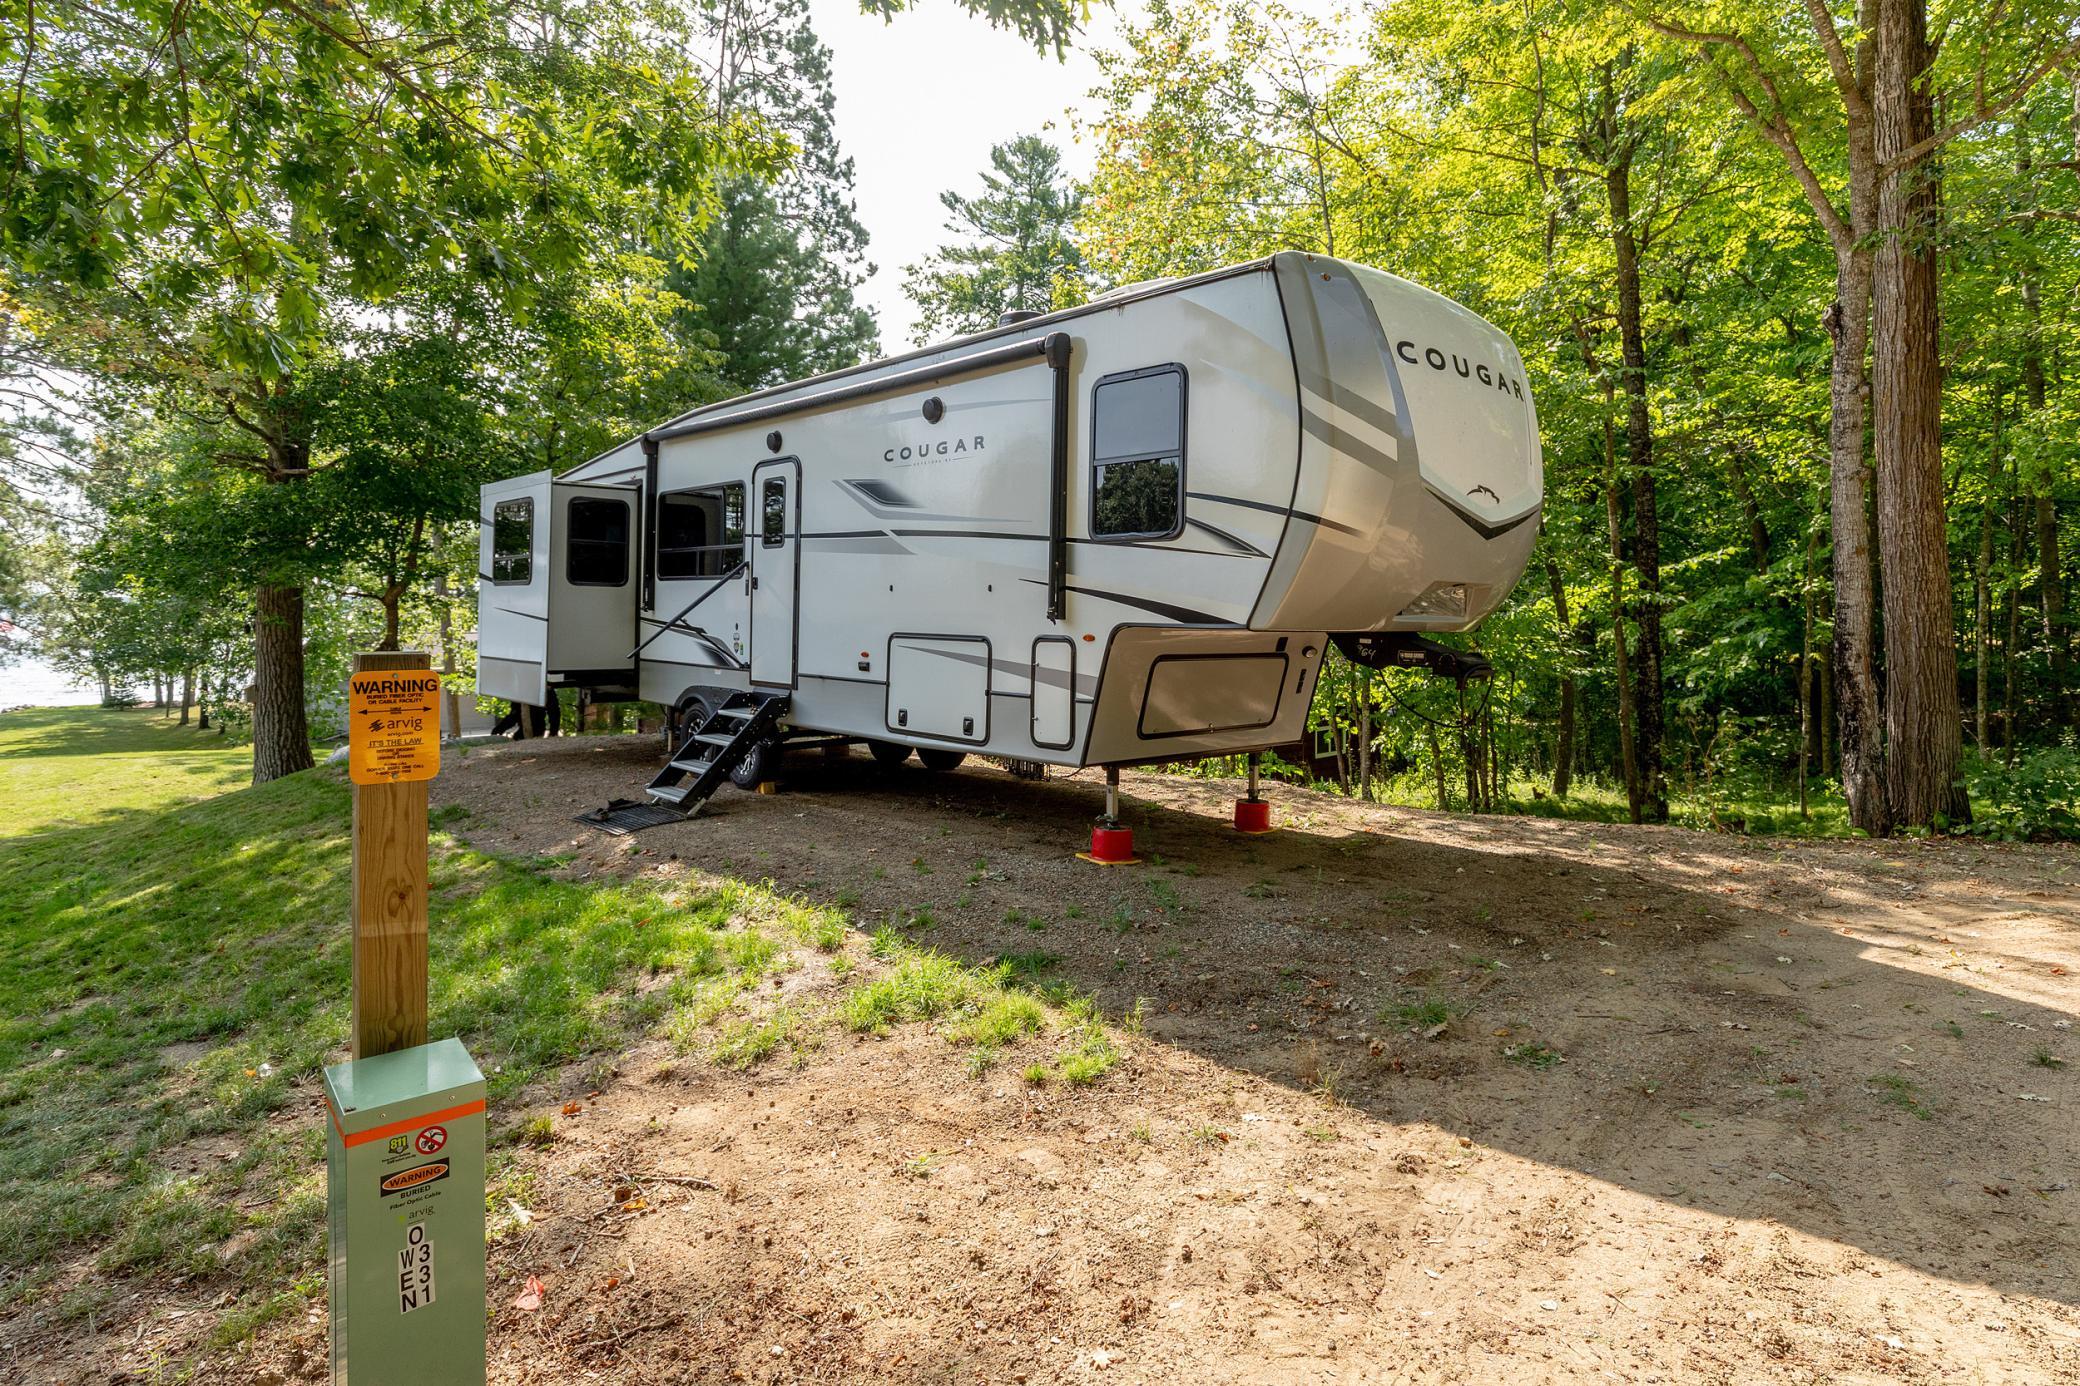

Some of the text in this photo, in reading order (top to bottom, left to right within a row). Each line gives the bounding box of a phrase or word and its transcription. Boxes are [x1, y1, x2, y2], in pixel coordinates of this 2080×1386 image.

[1396, 340, 1524, 402] COUGAR
[883, 435, 985, 462] COUGAR
[352, 678, 438, 695] WARNING
[387, 716, 423, 731] arvig
[404, 737, 422, 745] LAW
[390, 1136, 407, 1150] 811
[389, 1166, 441, 1187] WARNING
[400, 1184, 431, 1199] BURIED
[390, 1191, 442, 1210] Fiber Optic Cable
[409, 1205, 434, 1219] arvig
